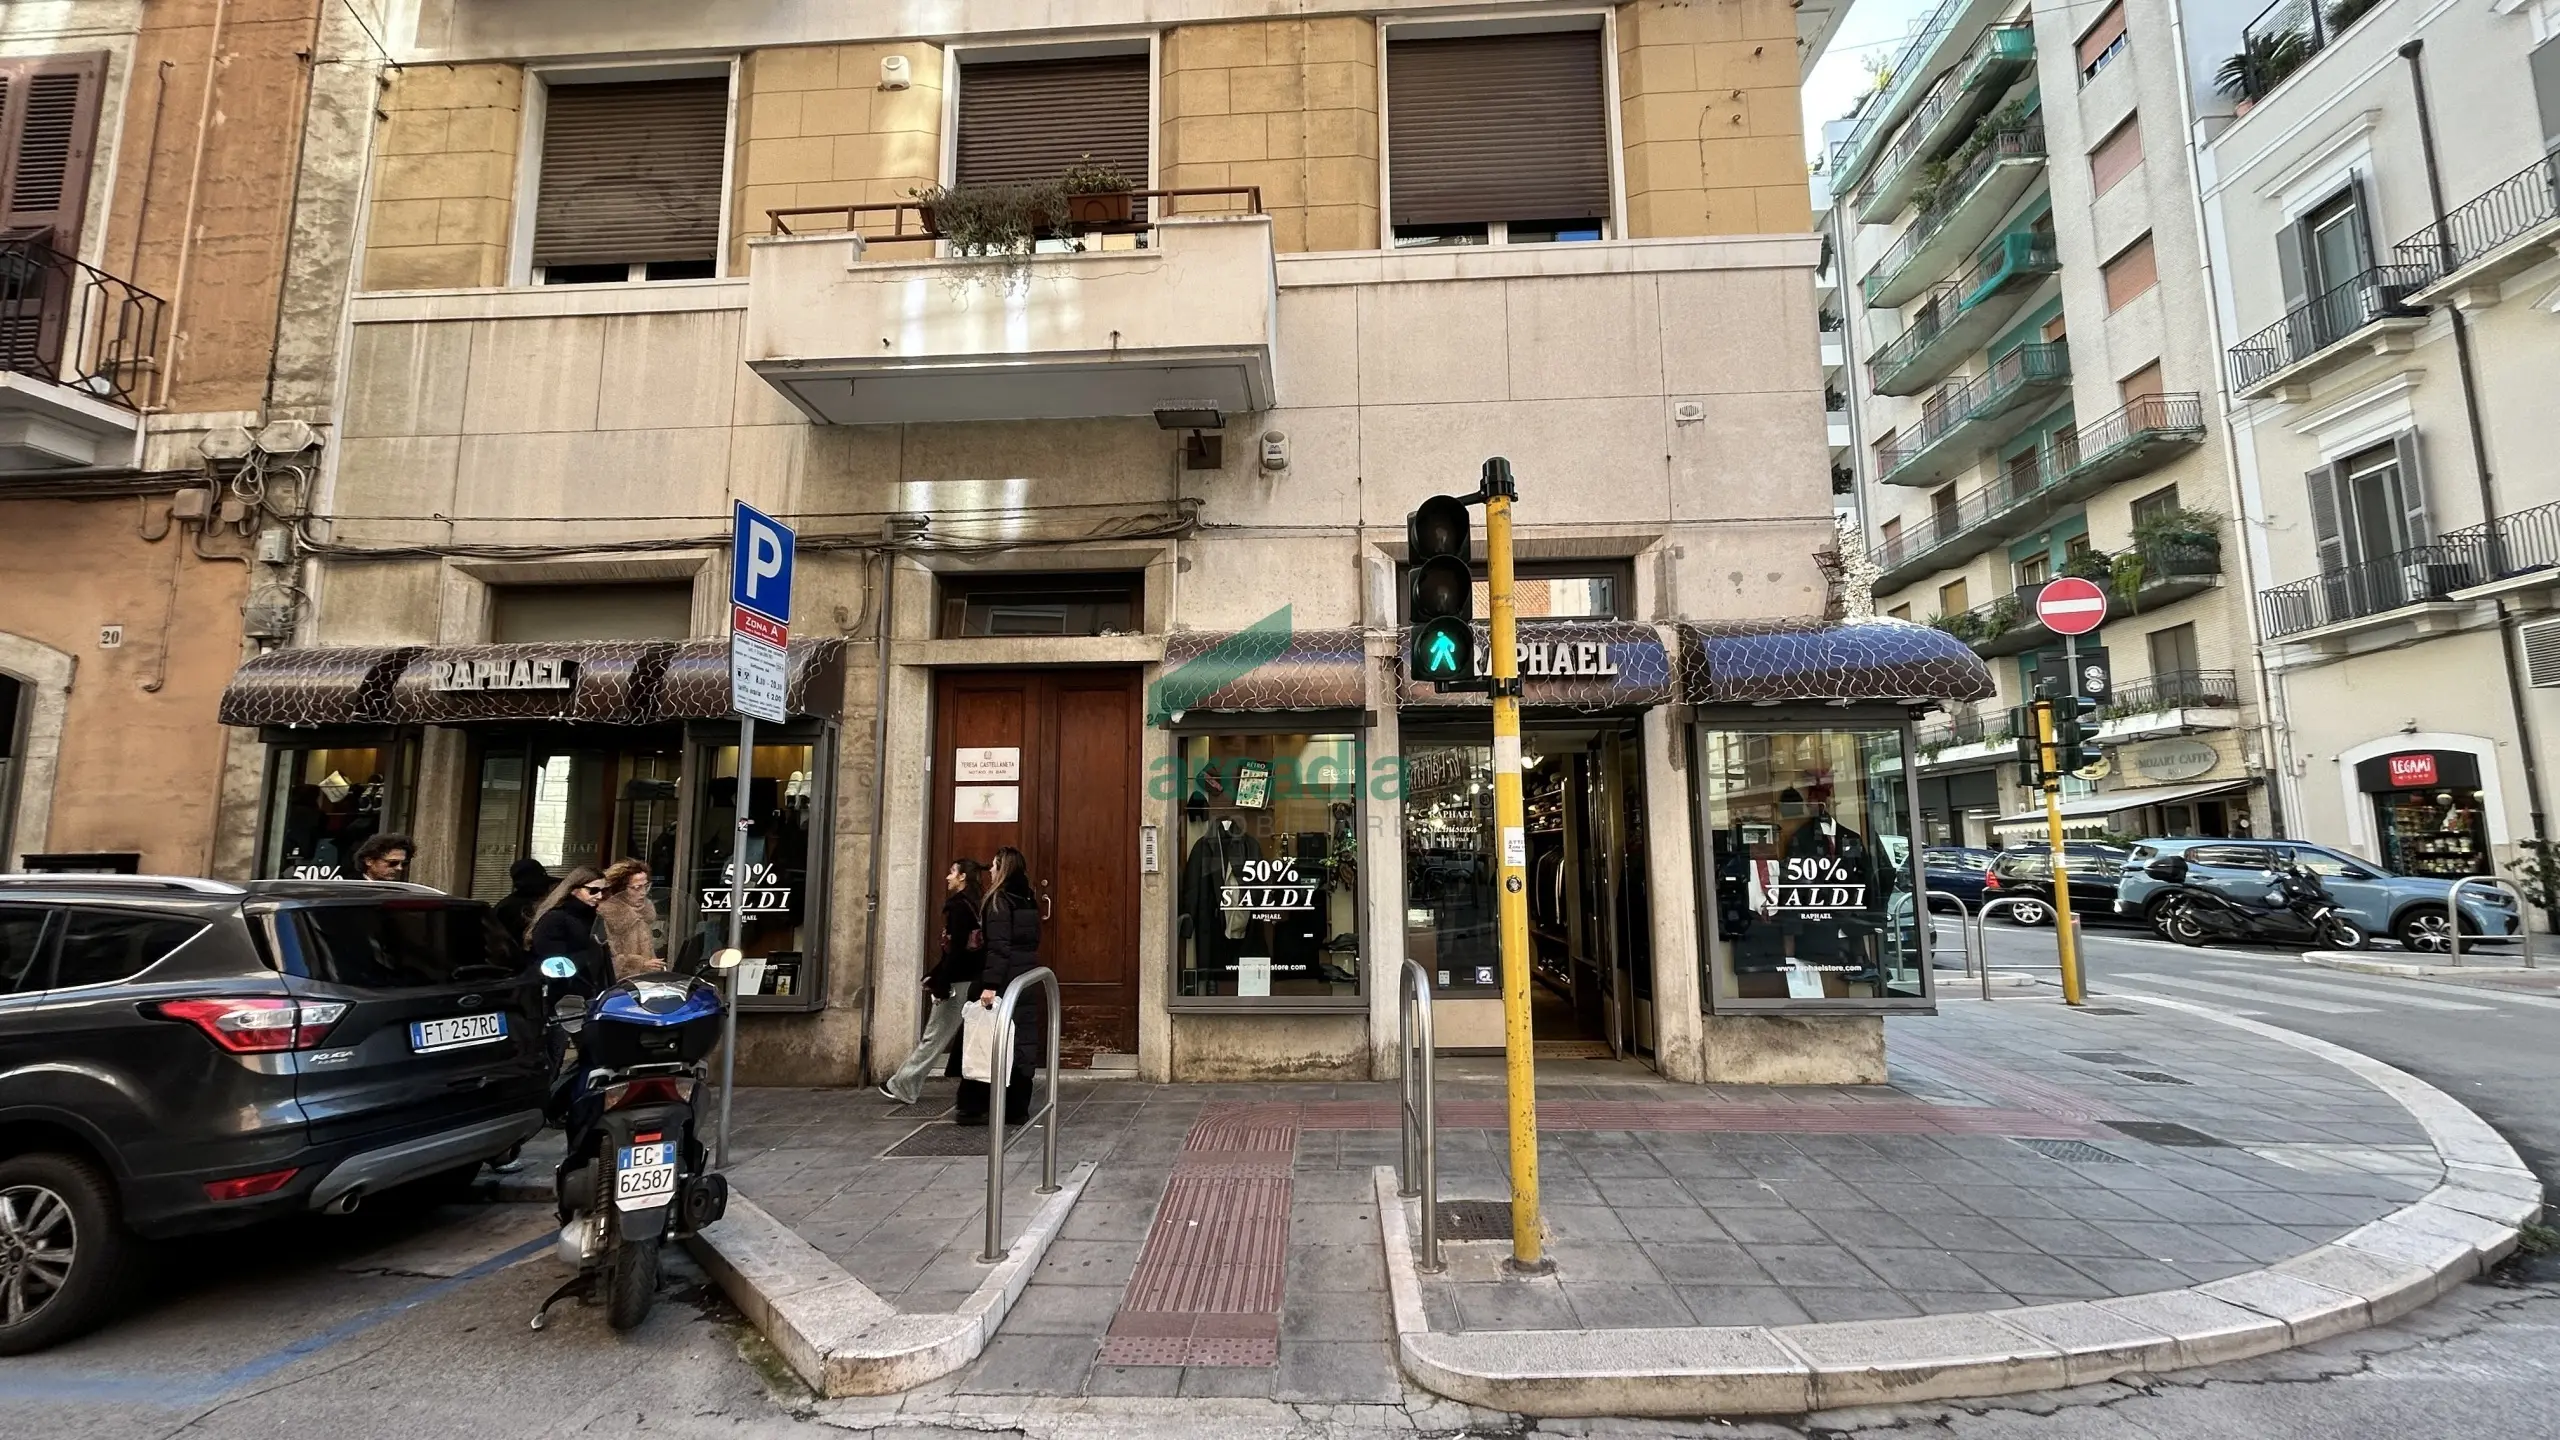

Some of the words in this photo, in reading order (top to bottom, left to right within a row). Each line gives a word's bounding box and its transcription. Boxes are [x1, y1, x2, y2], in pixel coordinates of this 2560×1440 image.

[746, 518, 782, 600] P
[102, 630, 120, 645] 20
[745, 616, 768, 633] ZONA
[770, 625, 779, 638] A
[429, 659, 570, 691] RAPHAEL
[2391, 757, 2431, 774] LEGAMI
[293, 865, 344, 881] 50%
[1242, 859, 1299, 882] 50%
[1787, 857, 1848, 881] 50%
[1220, 888, 1315, 907] SALDI
[1766, 887, 1866, 906] SALDI
[451, 1015, 498, 1040] 257RC
[633, 1146, 654, 1167] EG
[620, 1168, 672, 1193] 62587
